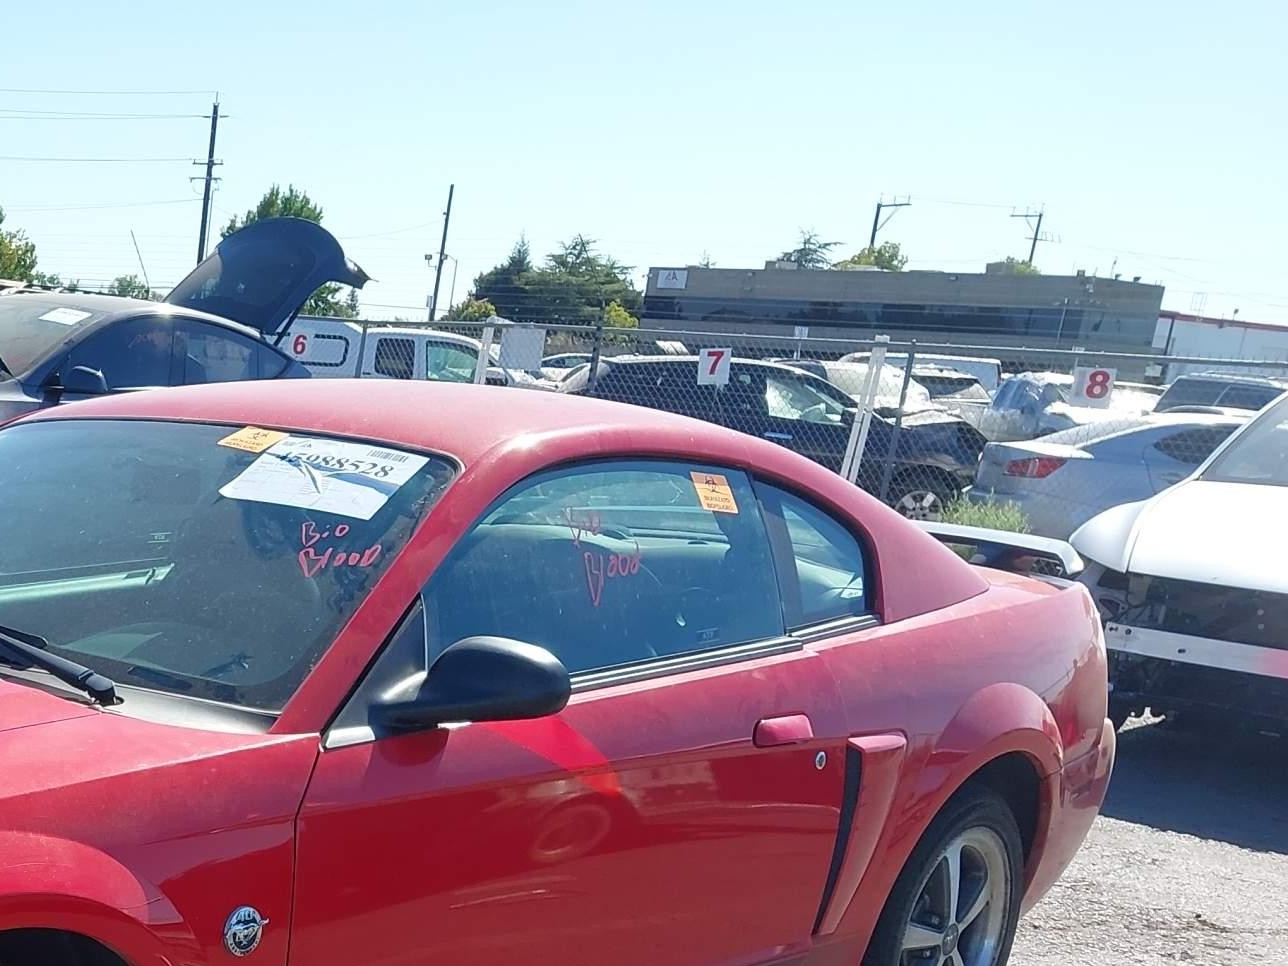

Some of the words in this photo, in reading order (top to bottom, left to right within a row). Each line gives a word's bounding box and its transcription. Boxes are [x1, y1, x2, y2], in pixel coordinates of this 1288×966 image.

[293, 334, 307, 355] 6
[707, 351, 725, 375] 7
[1086, 370, 1111, 399] 8
